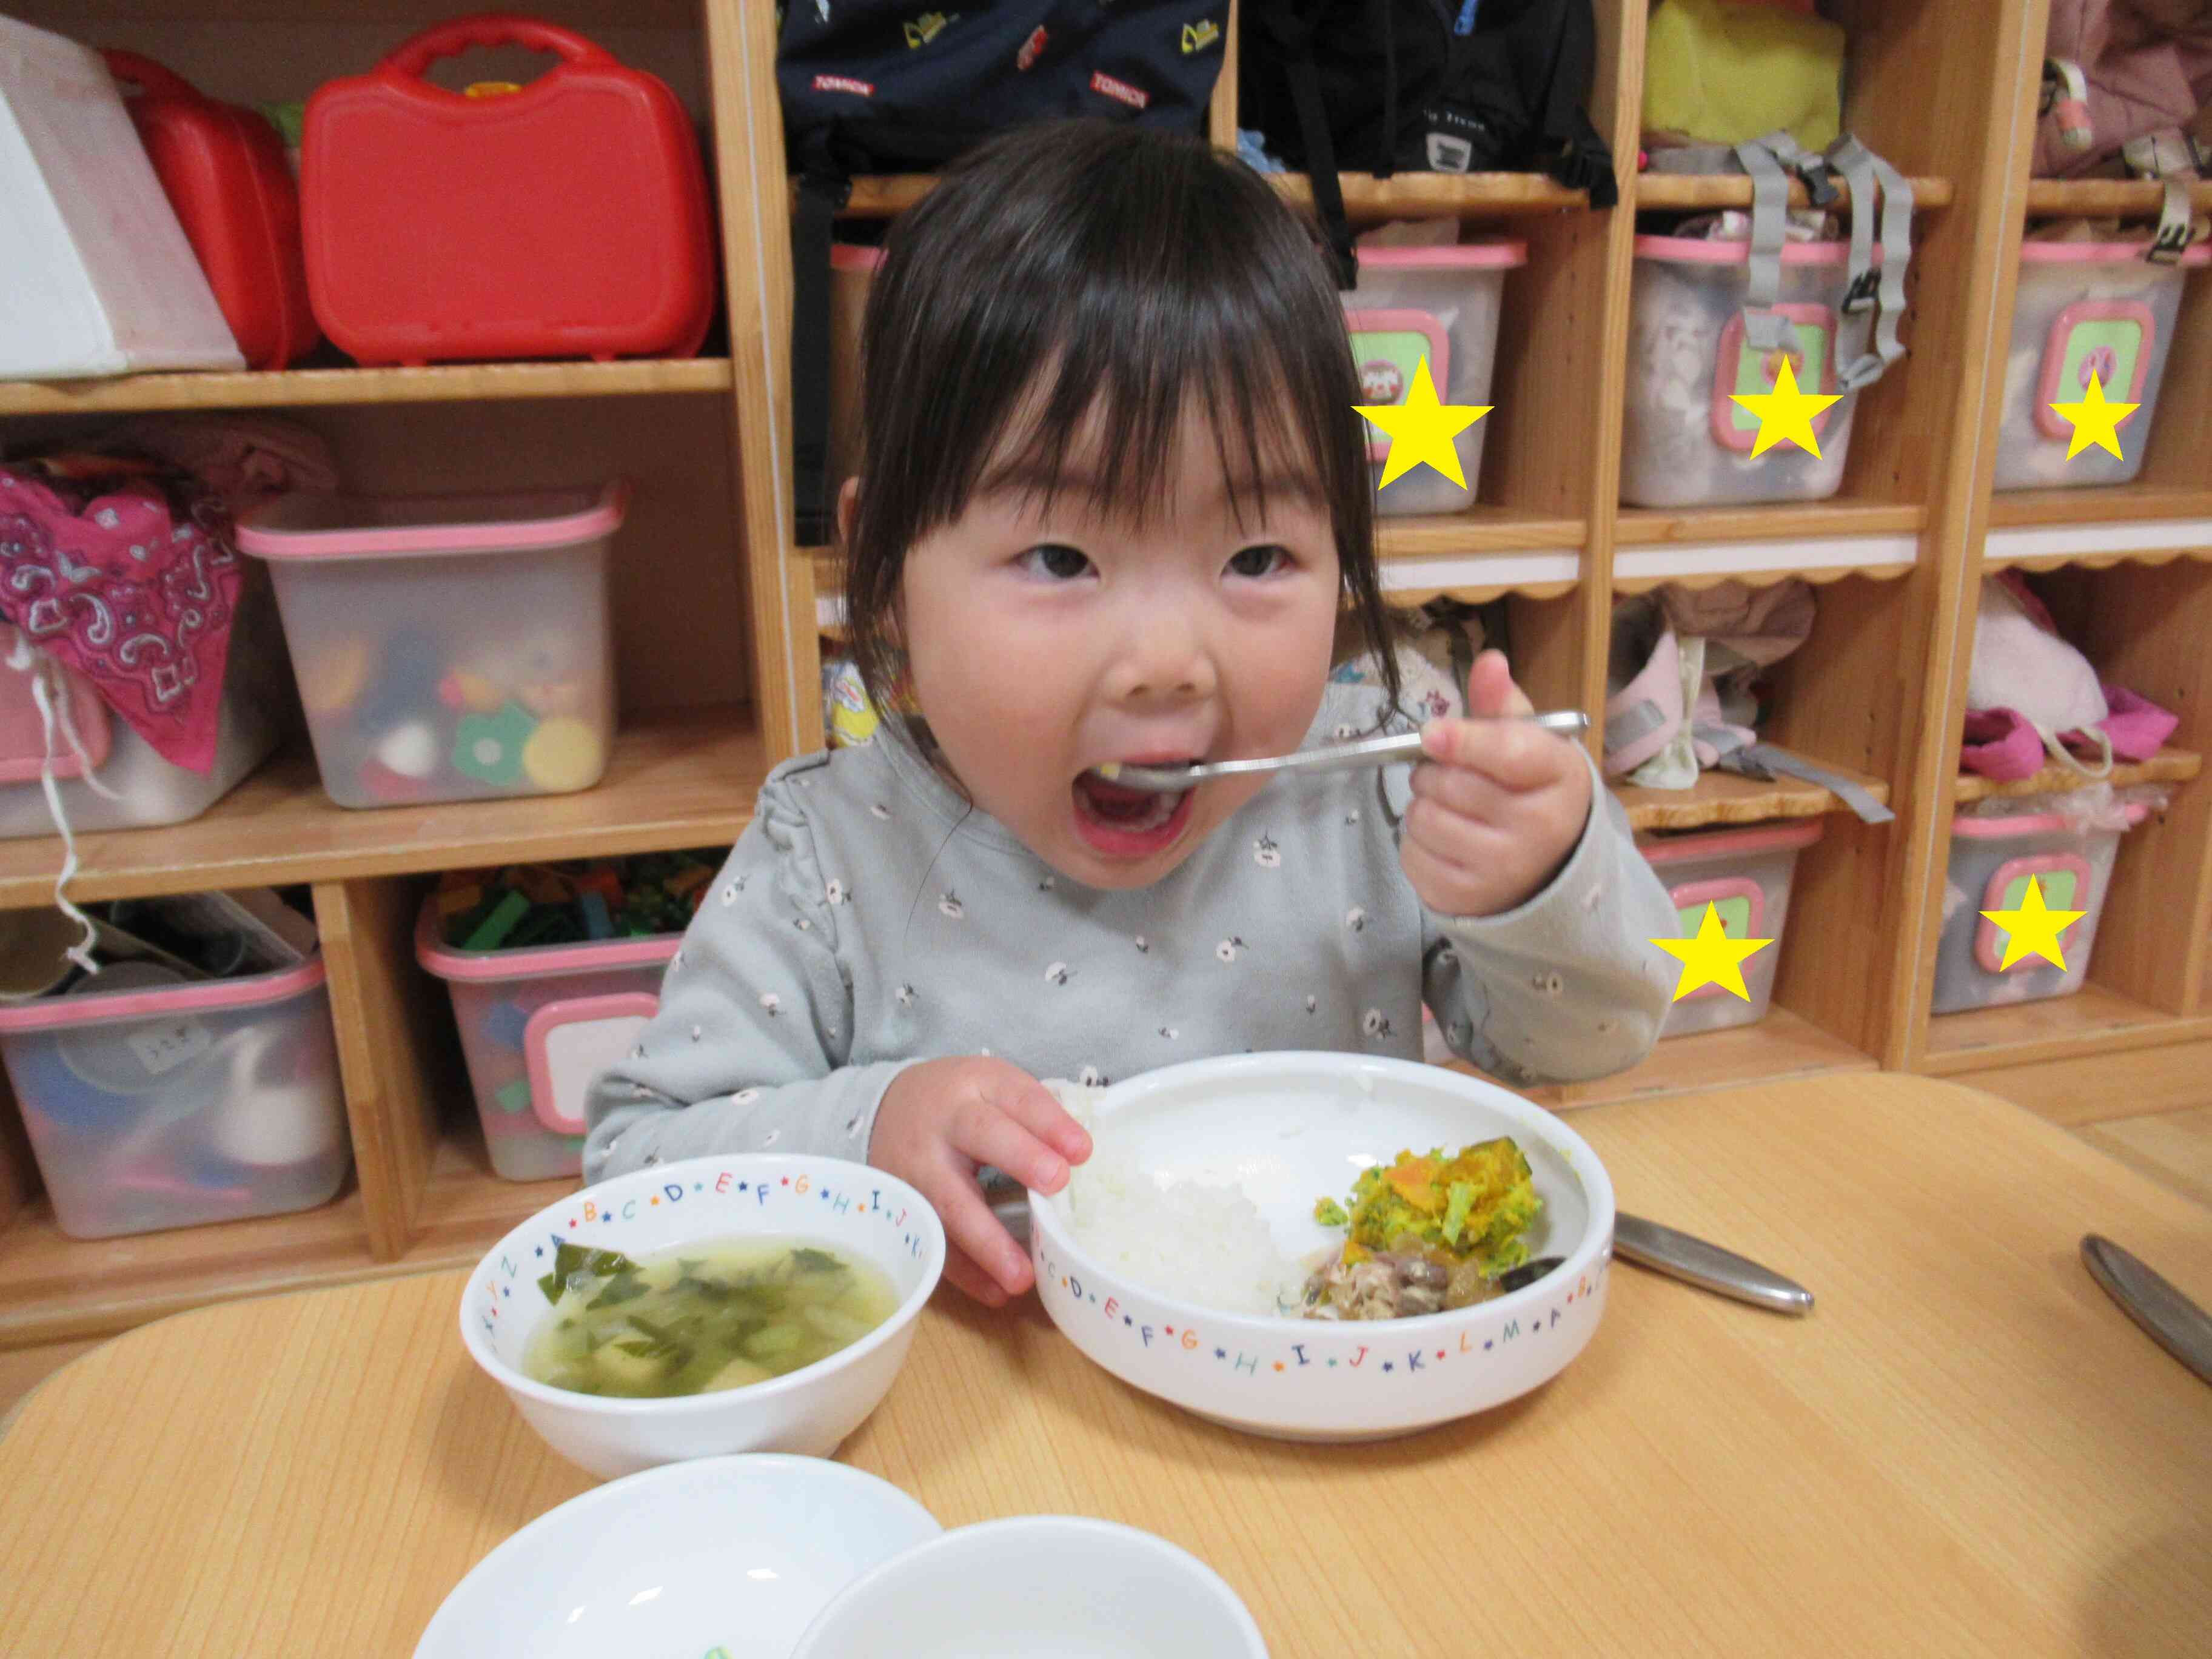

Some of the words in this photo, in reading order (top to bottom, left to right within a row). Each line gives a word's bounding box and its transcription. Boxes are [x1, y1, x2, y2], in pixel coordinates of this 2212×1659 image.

[584, 1202, 597, 1223] B
[622, 1199, 636, 1219] C
[664, 1184, 683, 1202] D
[715, 1171, 733, 1193] E
[757, 1184, 769, 1206] F
[795, 1173, 809, 1194] G
[833, 1191, 850, 1215] H
[872, 1190, 880, 1210] I
[896, 1207, 907, 1227] J
[1070, 1276, 1082, 1298] D
[1104, 1296, 1119, 1319] E
[1141, 1326, 1154, 1347] F
[1181, 1329, 1199, 1349] G
[1235, 1352, 1258, 1376] H
[1291, 1344, 1310, 1366] I
[1349, 1344, 1369, 1368] J
[1408, 1349, 1426, 1372] K
[1460, 1331, 1473, 1353] L
[1503, 1317, 1520, 1343] M
